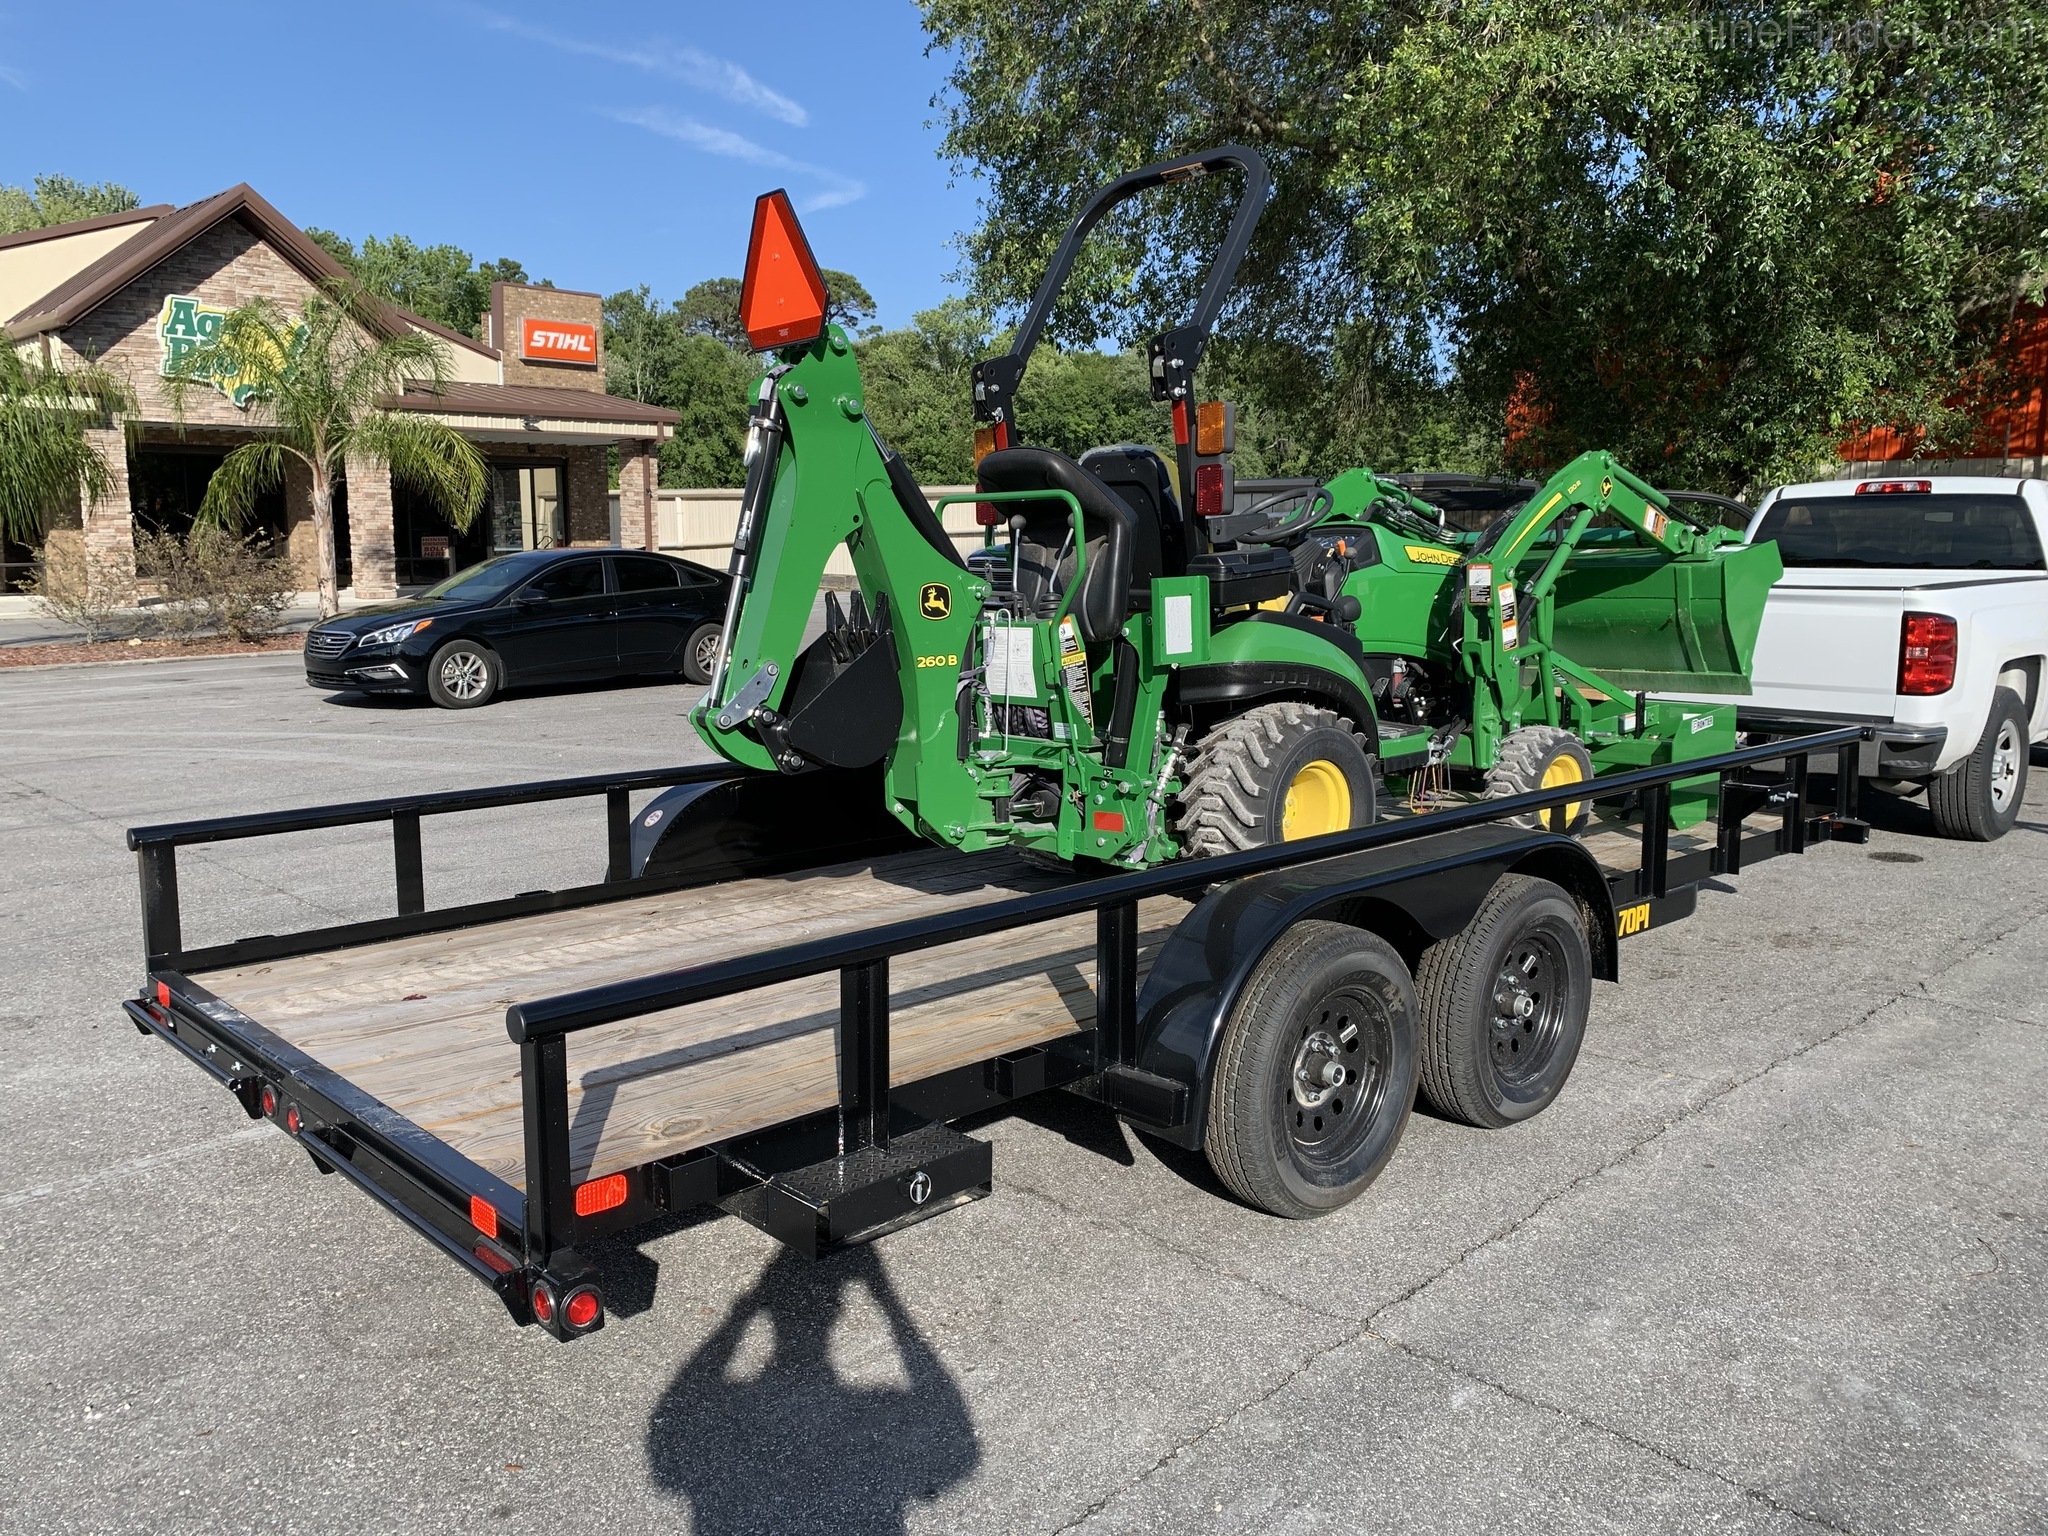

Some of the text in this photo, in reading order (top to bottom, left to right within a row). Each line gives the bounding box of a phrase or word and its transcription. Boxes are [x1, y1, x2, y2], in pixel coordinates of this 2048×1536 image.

[529, 329, 592, 353] STIHL
[1415, 550, 1466, 565] JOHN DEER
[916, 655, 946, 668] 260
[1618, 903, 1650, 937] 70PI
